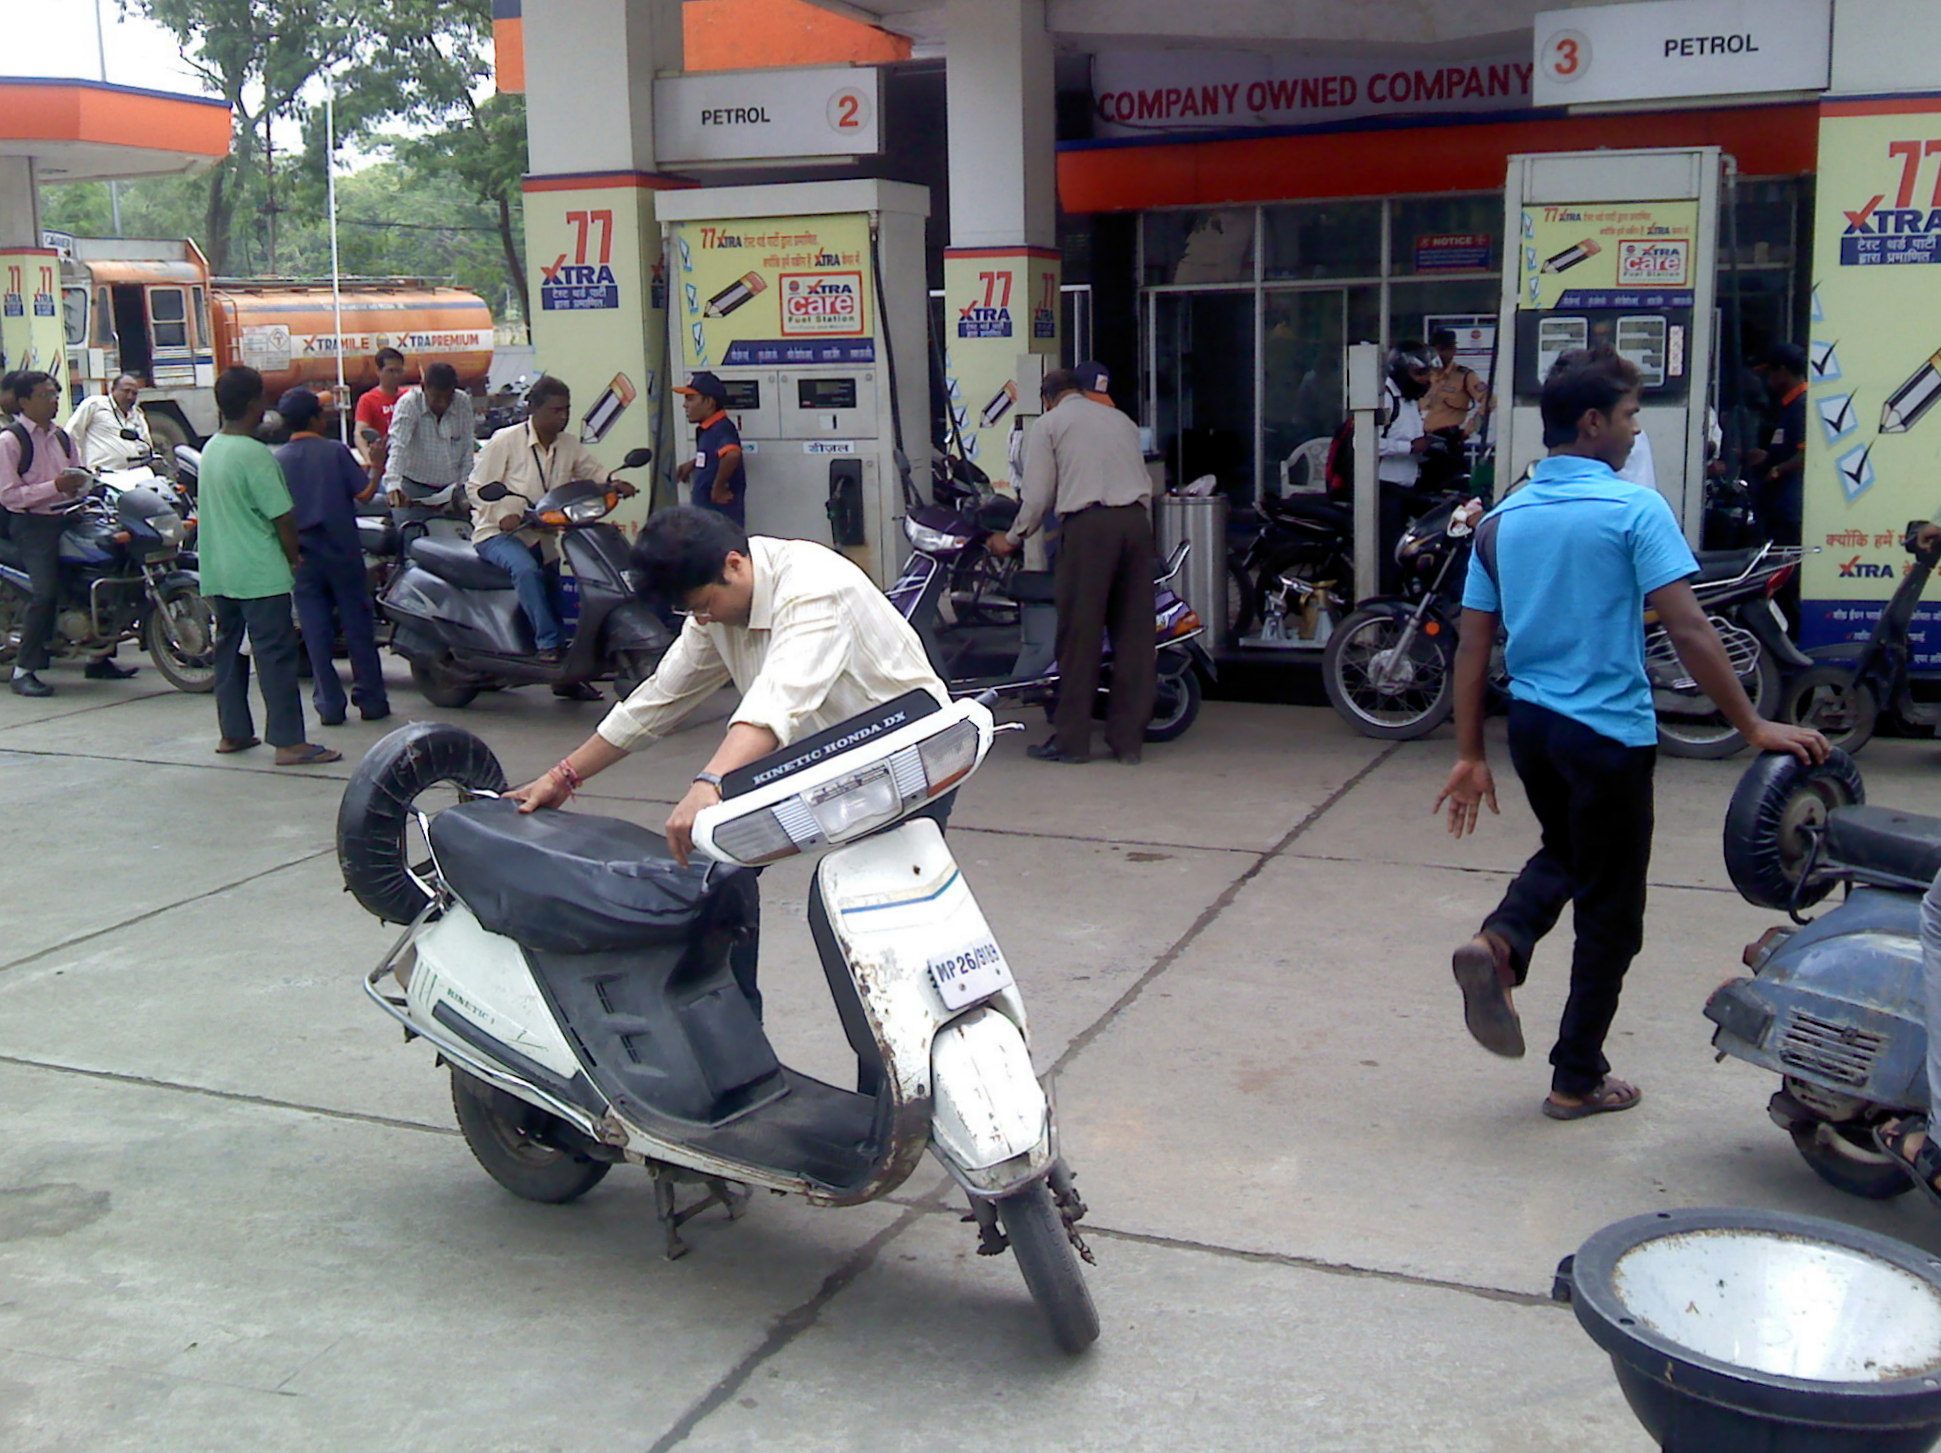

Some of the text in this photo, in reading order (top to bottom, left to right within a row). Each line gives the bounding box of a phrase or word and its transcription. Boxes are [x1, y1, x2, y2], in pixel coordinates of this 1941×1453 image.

[1554, 39, 1580, 75] 3
[1664, 34, 1759, 57] PETROL
[1100, 62, 1533, 122] COMPANY OWNED COMPANY
[701, 107, 770, 126] PETROL
[838, 95, 859, 128] 2
[1843, 194, 1941, 234] XTRA
[566, 210, 613, 264] 77
[700, 227, 716, 249] 77
[717, 228, 742, 249] XTRA
[815, 247, 841, 267] XTRA
[1626, 256, 1680, 271] care
[540, 254, 615, 285] XTRA
[806, 279, 853, 294] XTRA
[979, 271, 1012, 307] 77
[789, 295, 853, 315] care
[959, 300, 1011, 320] XTRA
[816, 315, 855, 323] Station
[1839, 555, 1894, 578] XTRA
[752, 711, 907, 786] KINETIC HONDA DX
[447, 987, 490, 1021] KINETIC
